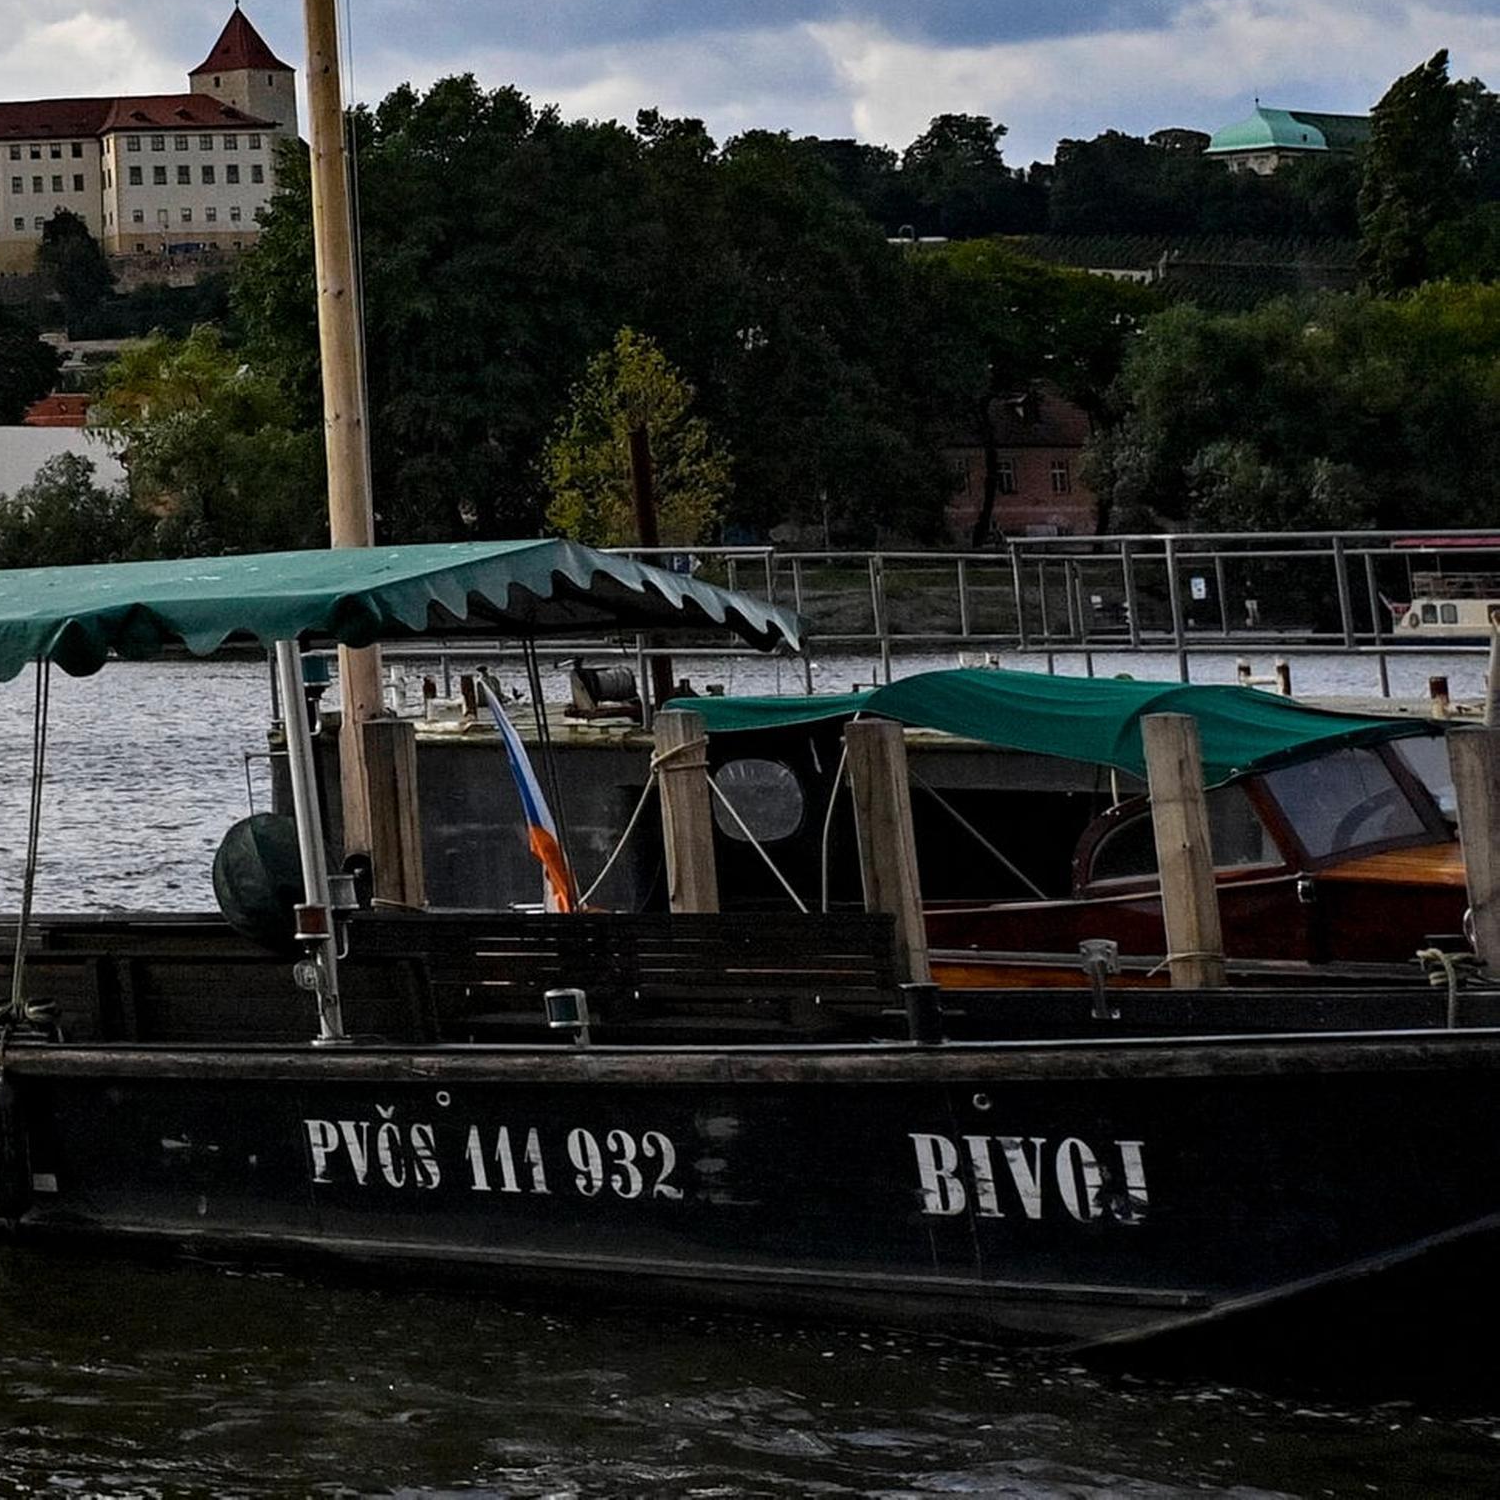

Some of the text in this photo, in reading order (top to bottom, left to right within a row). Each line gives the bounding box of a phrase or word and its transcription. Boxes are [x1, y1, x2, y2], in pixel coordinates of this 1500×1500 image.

[303, 1104, 684, 1199] PVČS 111 932
